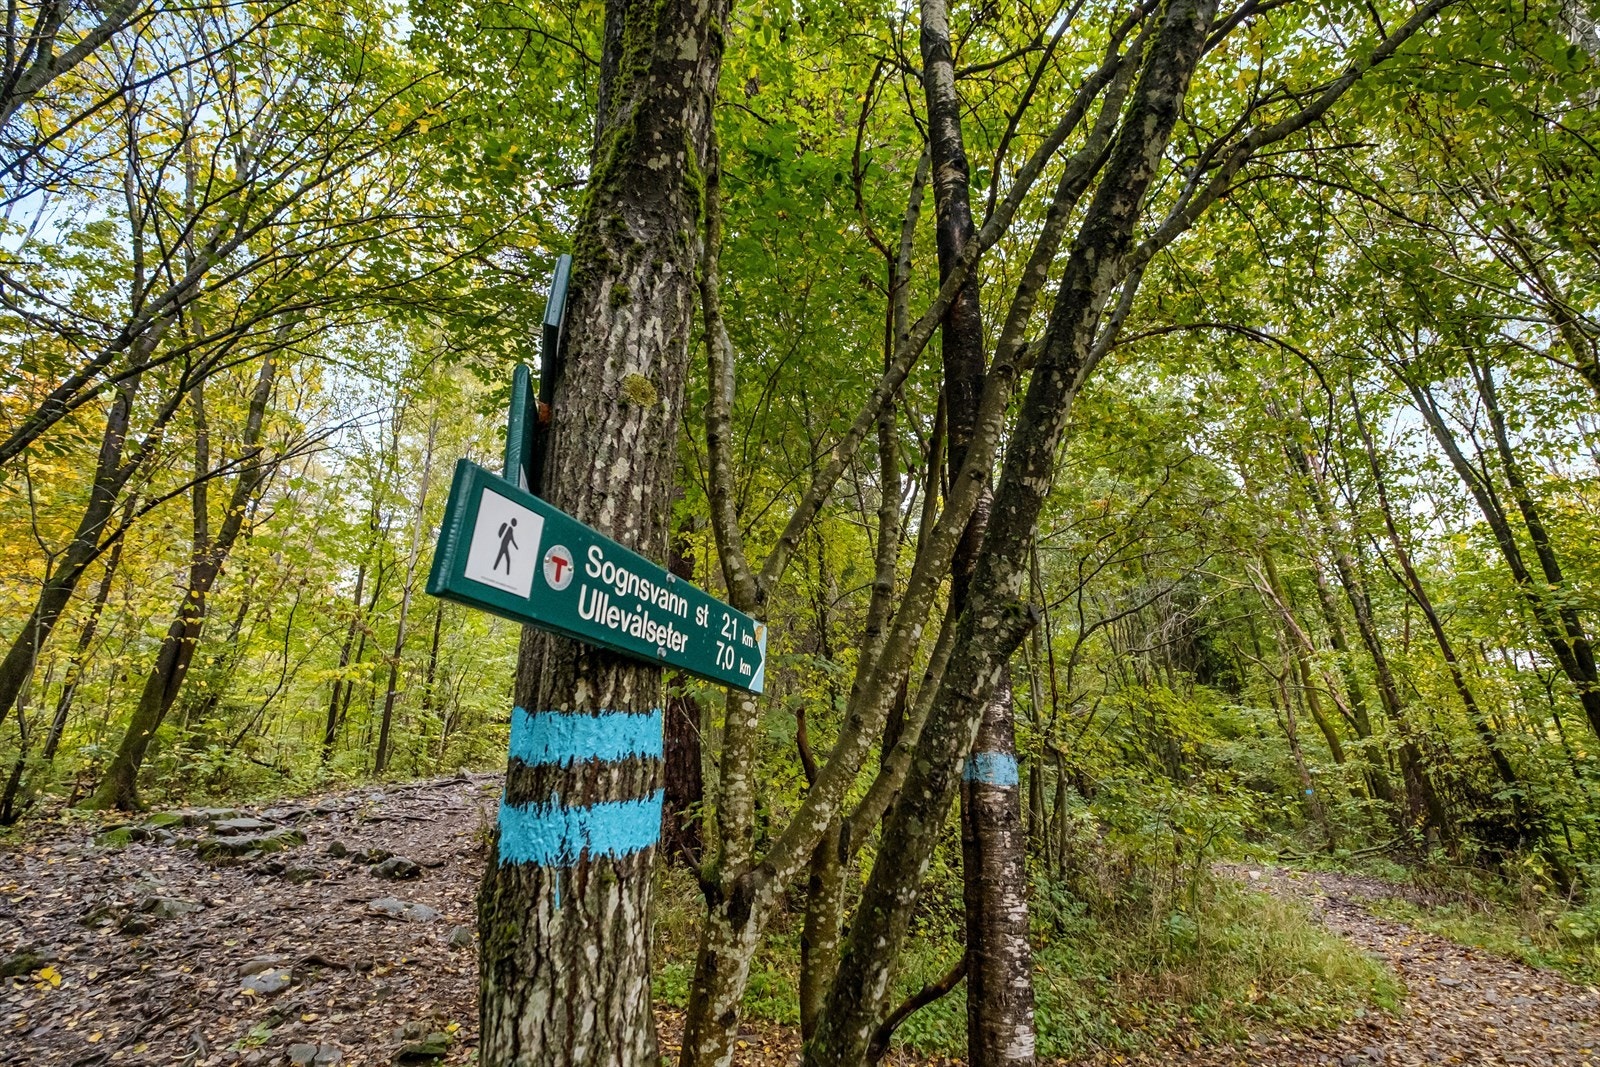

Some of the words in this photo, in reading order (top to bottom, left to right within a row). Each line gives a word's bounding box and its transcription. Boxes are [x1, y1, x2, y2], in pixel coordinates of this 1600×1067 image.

[551, 555, 568, 583] T
[585, 545, 688, 619] Sognsvann
[695, 604, 709, 628] st
[721, 612, 738, 642] 2,1
[742, 629, 754, 648] km
[577, 583, 689, 653] Ullevålseter
[715, 640, 735, 670] 7,0
[739, 658, 752, 677] km
